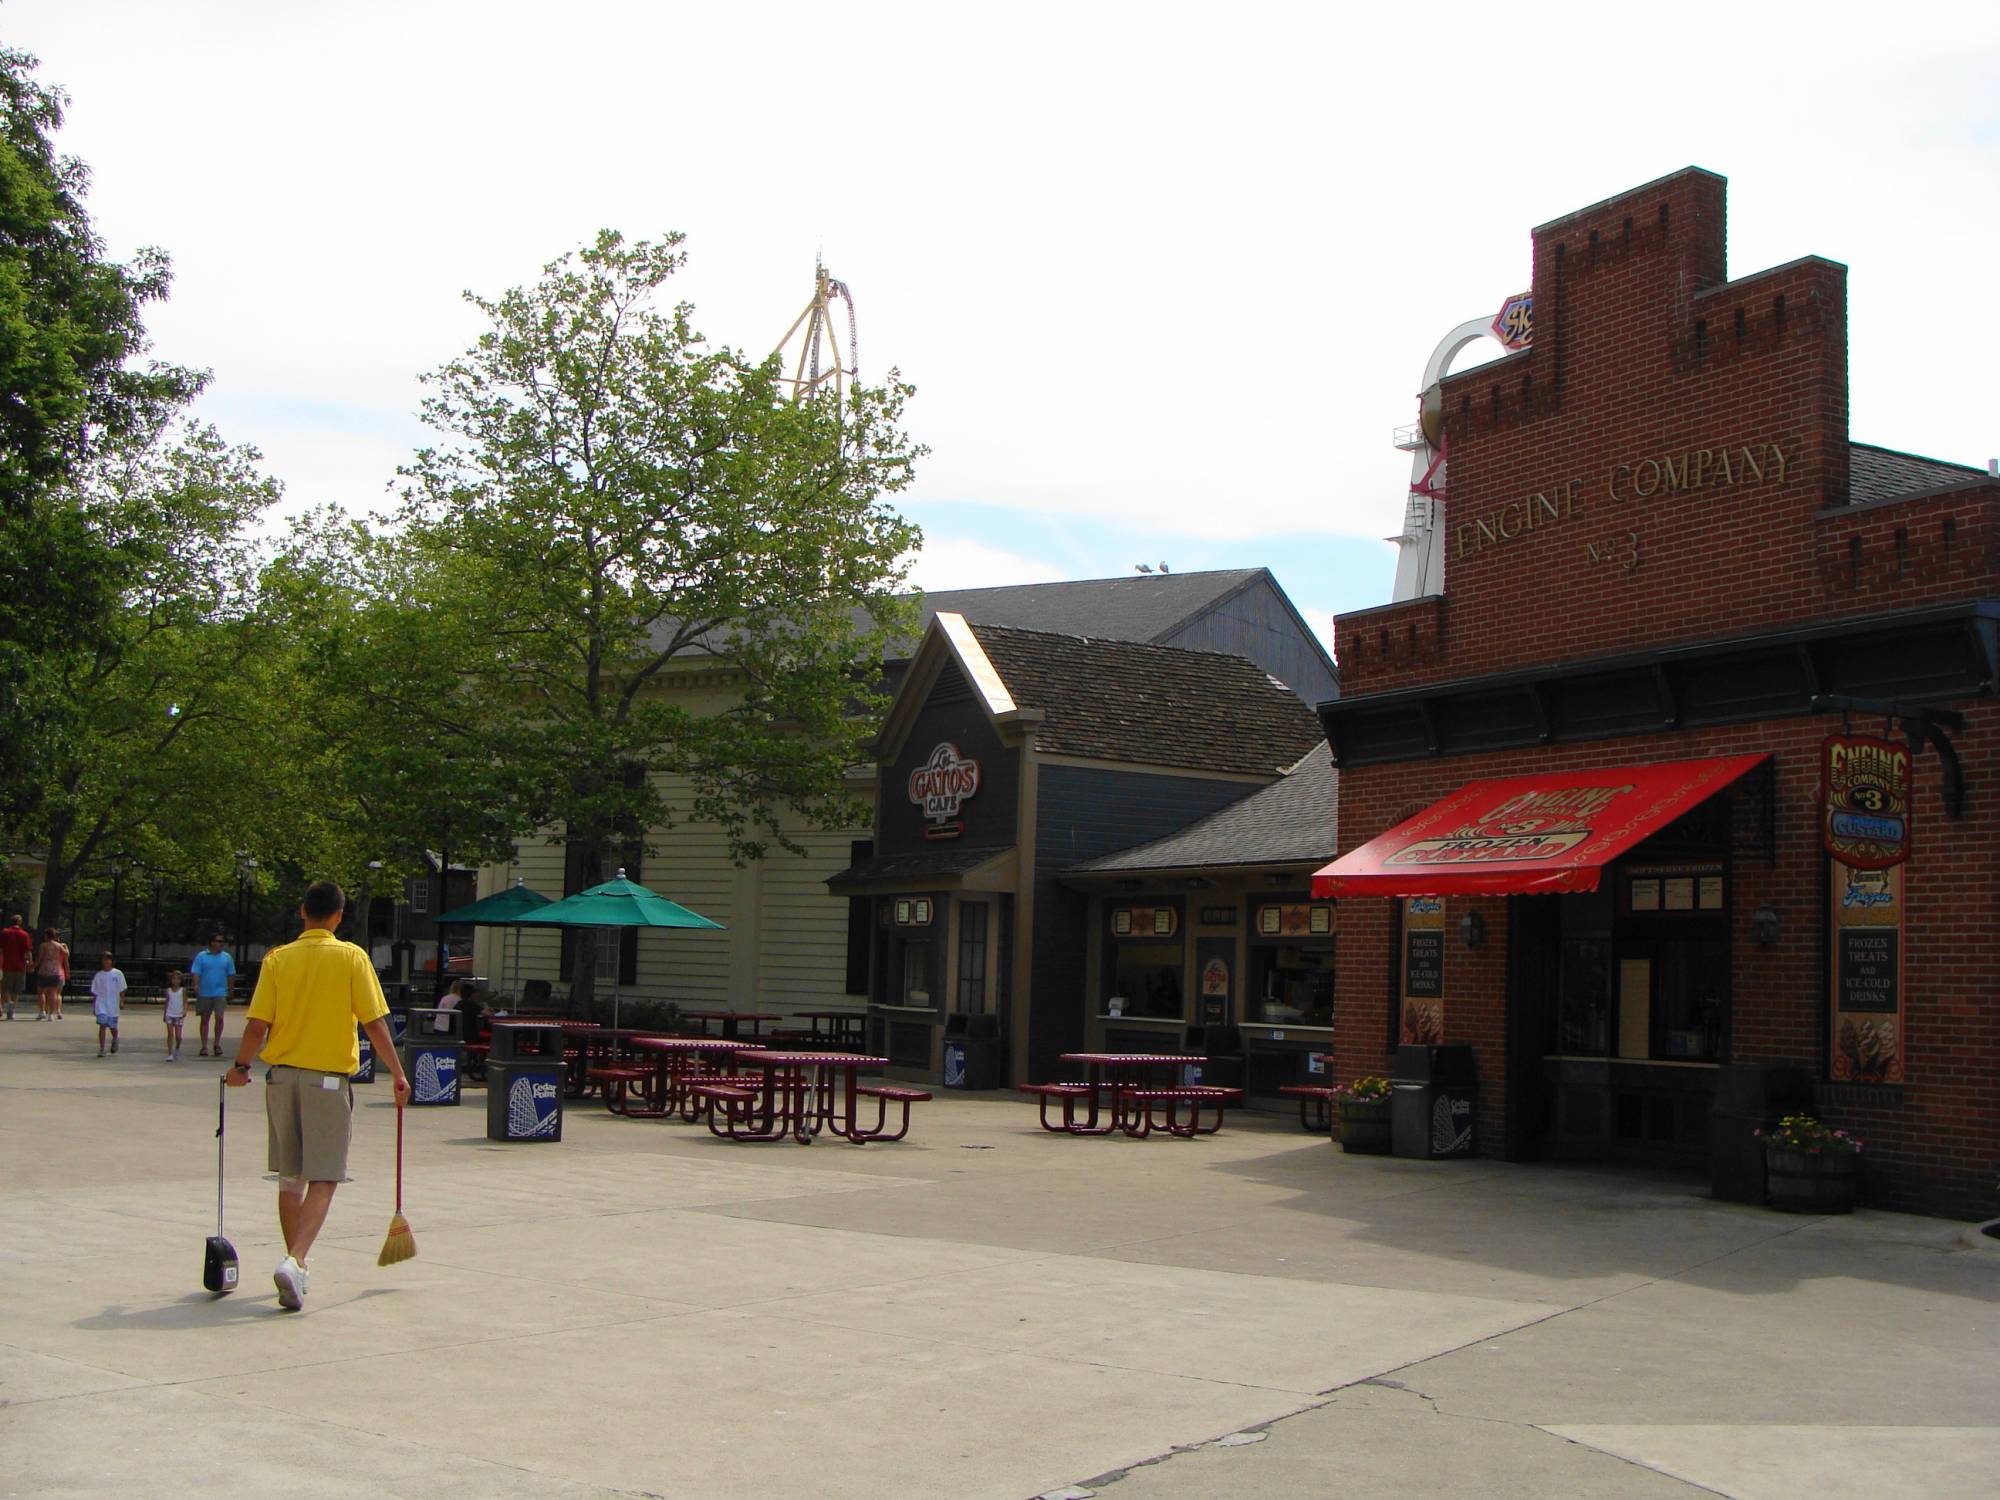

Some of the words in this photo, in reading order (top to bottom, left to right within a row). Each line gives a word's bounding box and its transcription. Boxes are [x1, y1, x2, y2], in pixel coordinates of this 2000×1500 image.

[1457, 479, 1584, 559] ENGINE
[1608, 443, 1791, 501] COMPANY
[1623, 532, 1638, 569] 3
[1830, 743, 1907, 796] ENGINE
[911, 766, 975, 799] GATOS
[1847, 773, 1890, 791] COMPANY
[1477, 784, 1637, 824] ENGINE
[1864, 789, 1883, 811] 3
[1437, 836, 1551, 851] FROZEN
[1848, 937, 1888, 949] FROZEN
[1848, 951, 1889, 962] TREATS
[1846, 977, 1890, 989] ICE-COLD
[1849, 991, 1887, 1002] DRINKS
[435, 1057, 457, 1065] Cedar
[532, 1082, 558, 1091] Cedar
[533, 1090, 556, 1098] Point
